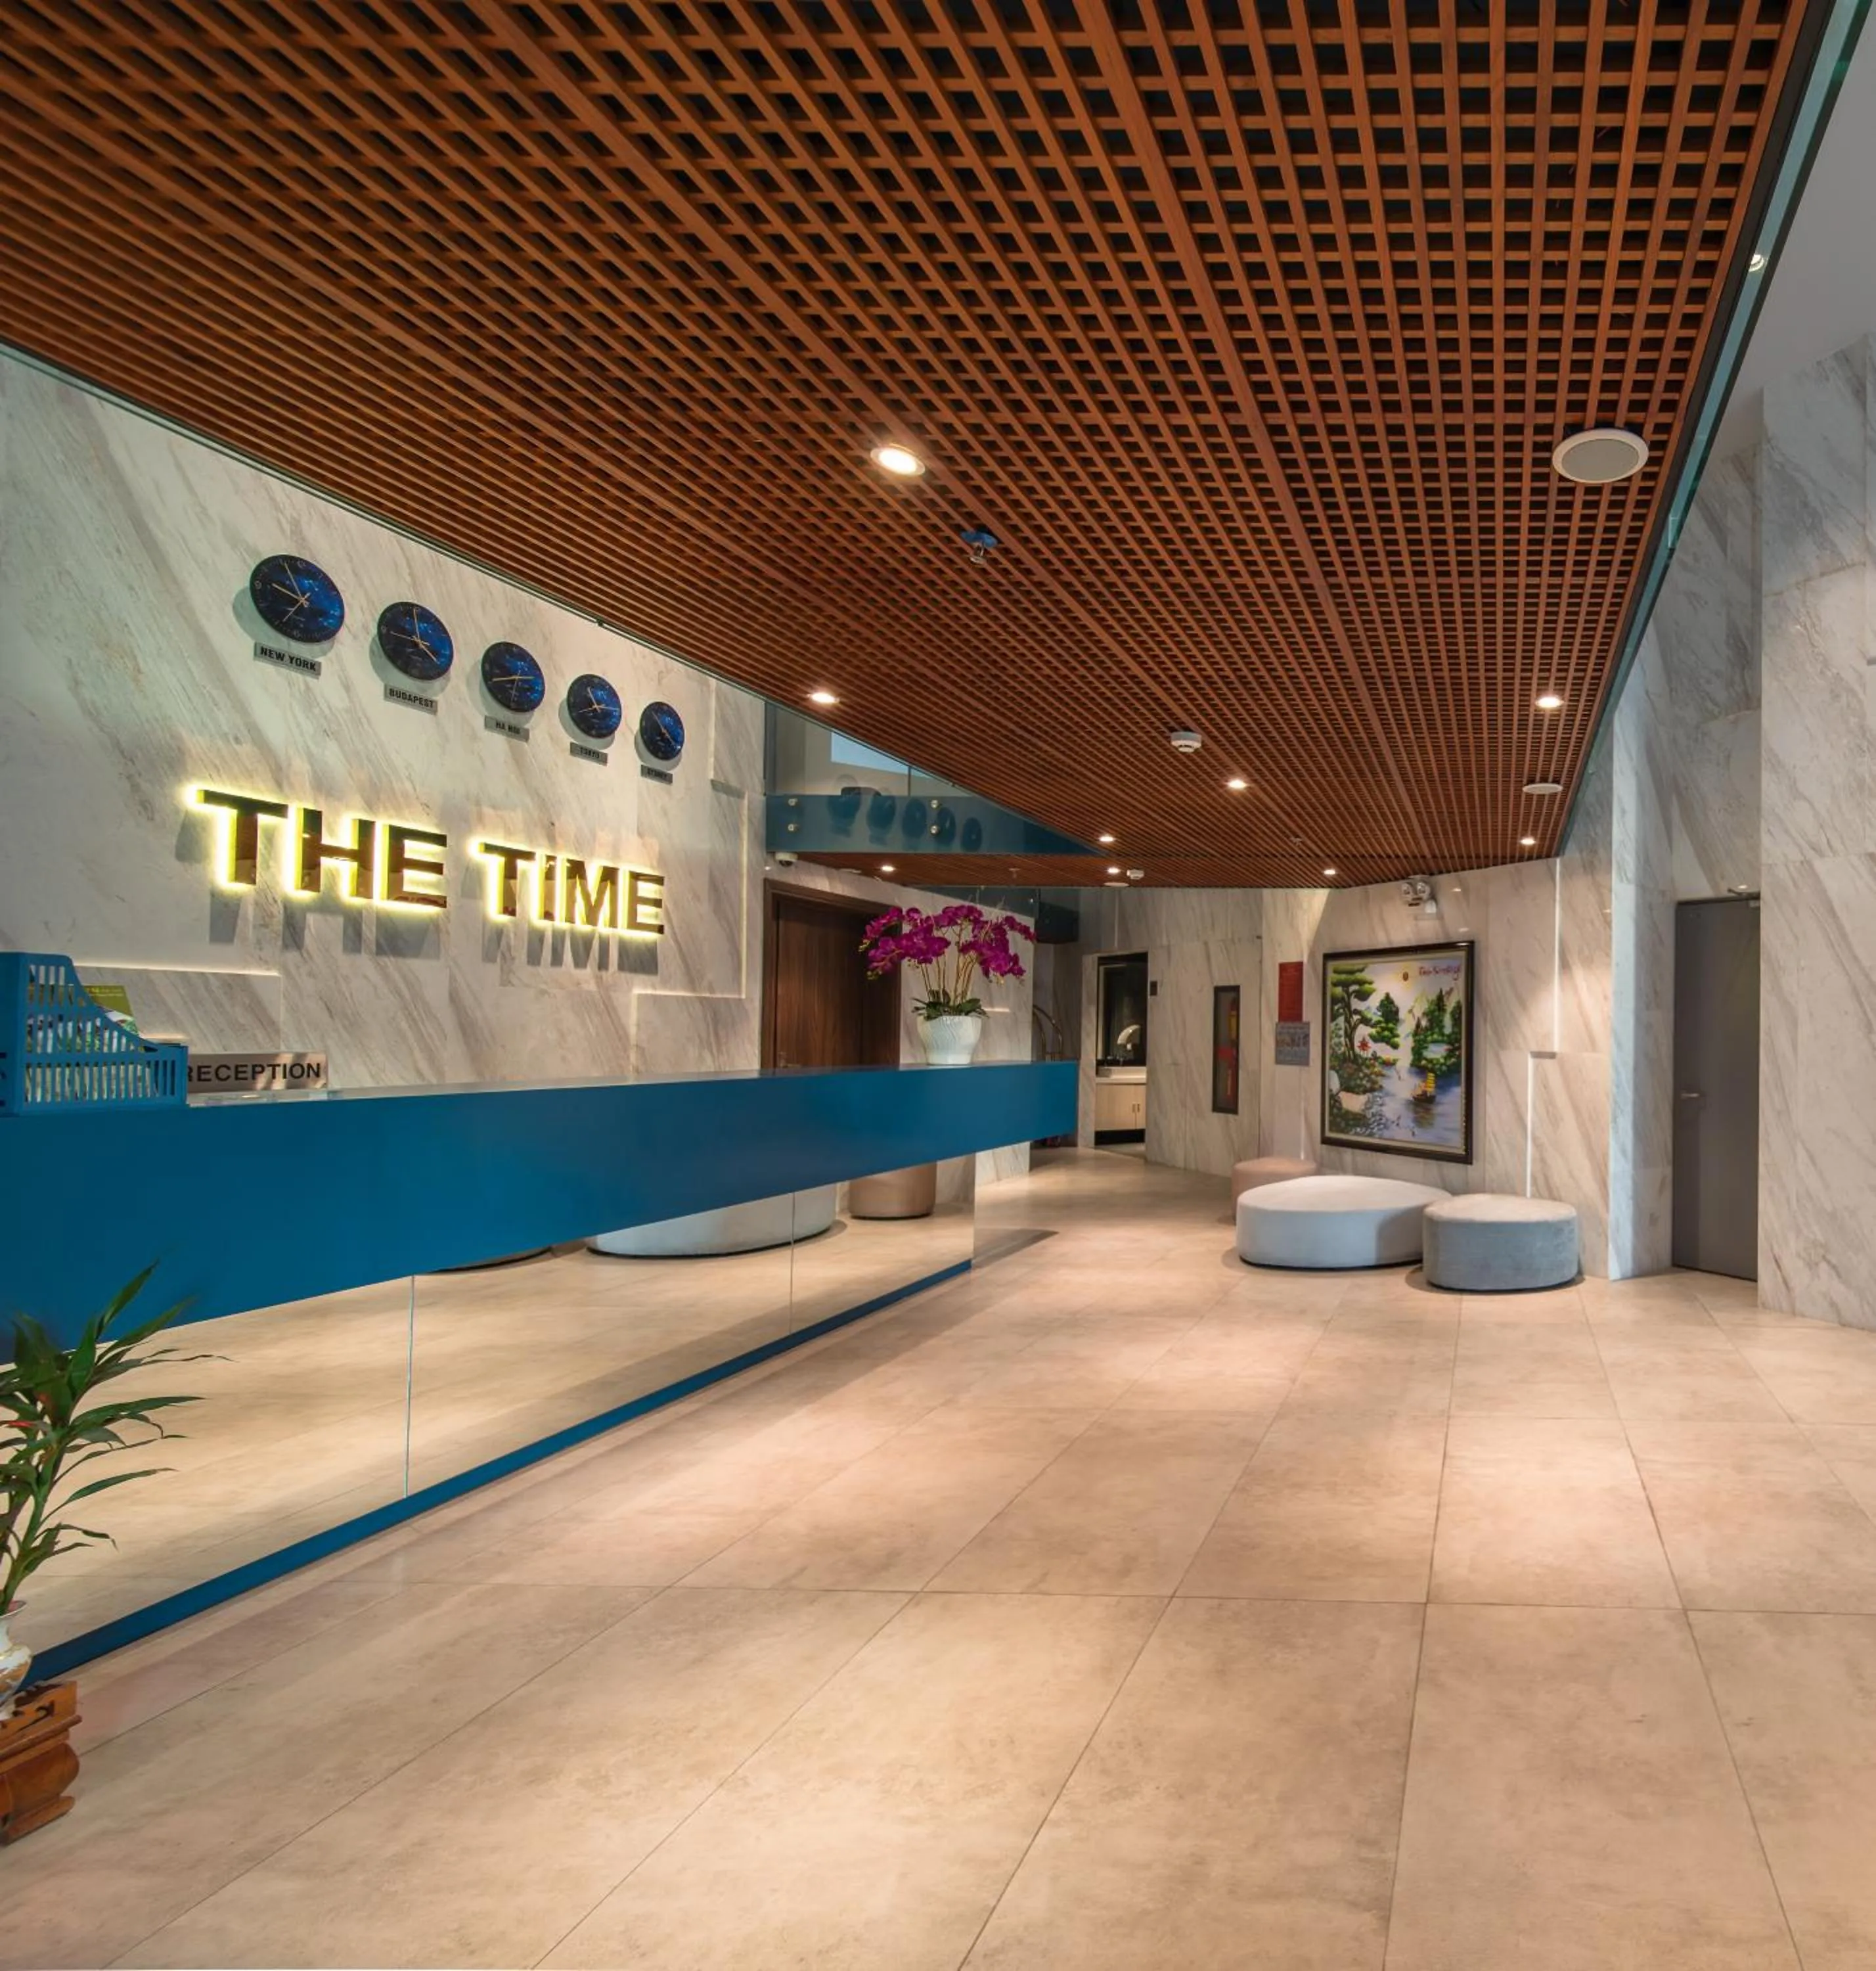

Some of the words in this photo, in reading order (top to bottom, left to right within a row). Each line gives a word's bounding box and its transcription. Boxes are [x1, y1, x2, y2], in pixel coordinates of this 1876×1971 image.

[261, 646, 284, 661] NEW
[289, 654, 317, 671] YORK
[389, 688, 434, 709] BUDAPEST
[197, 788, 447, 909] THE
[479, 842, 665, 935] TIME
